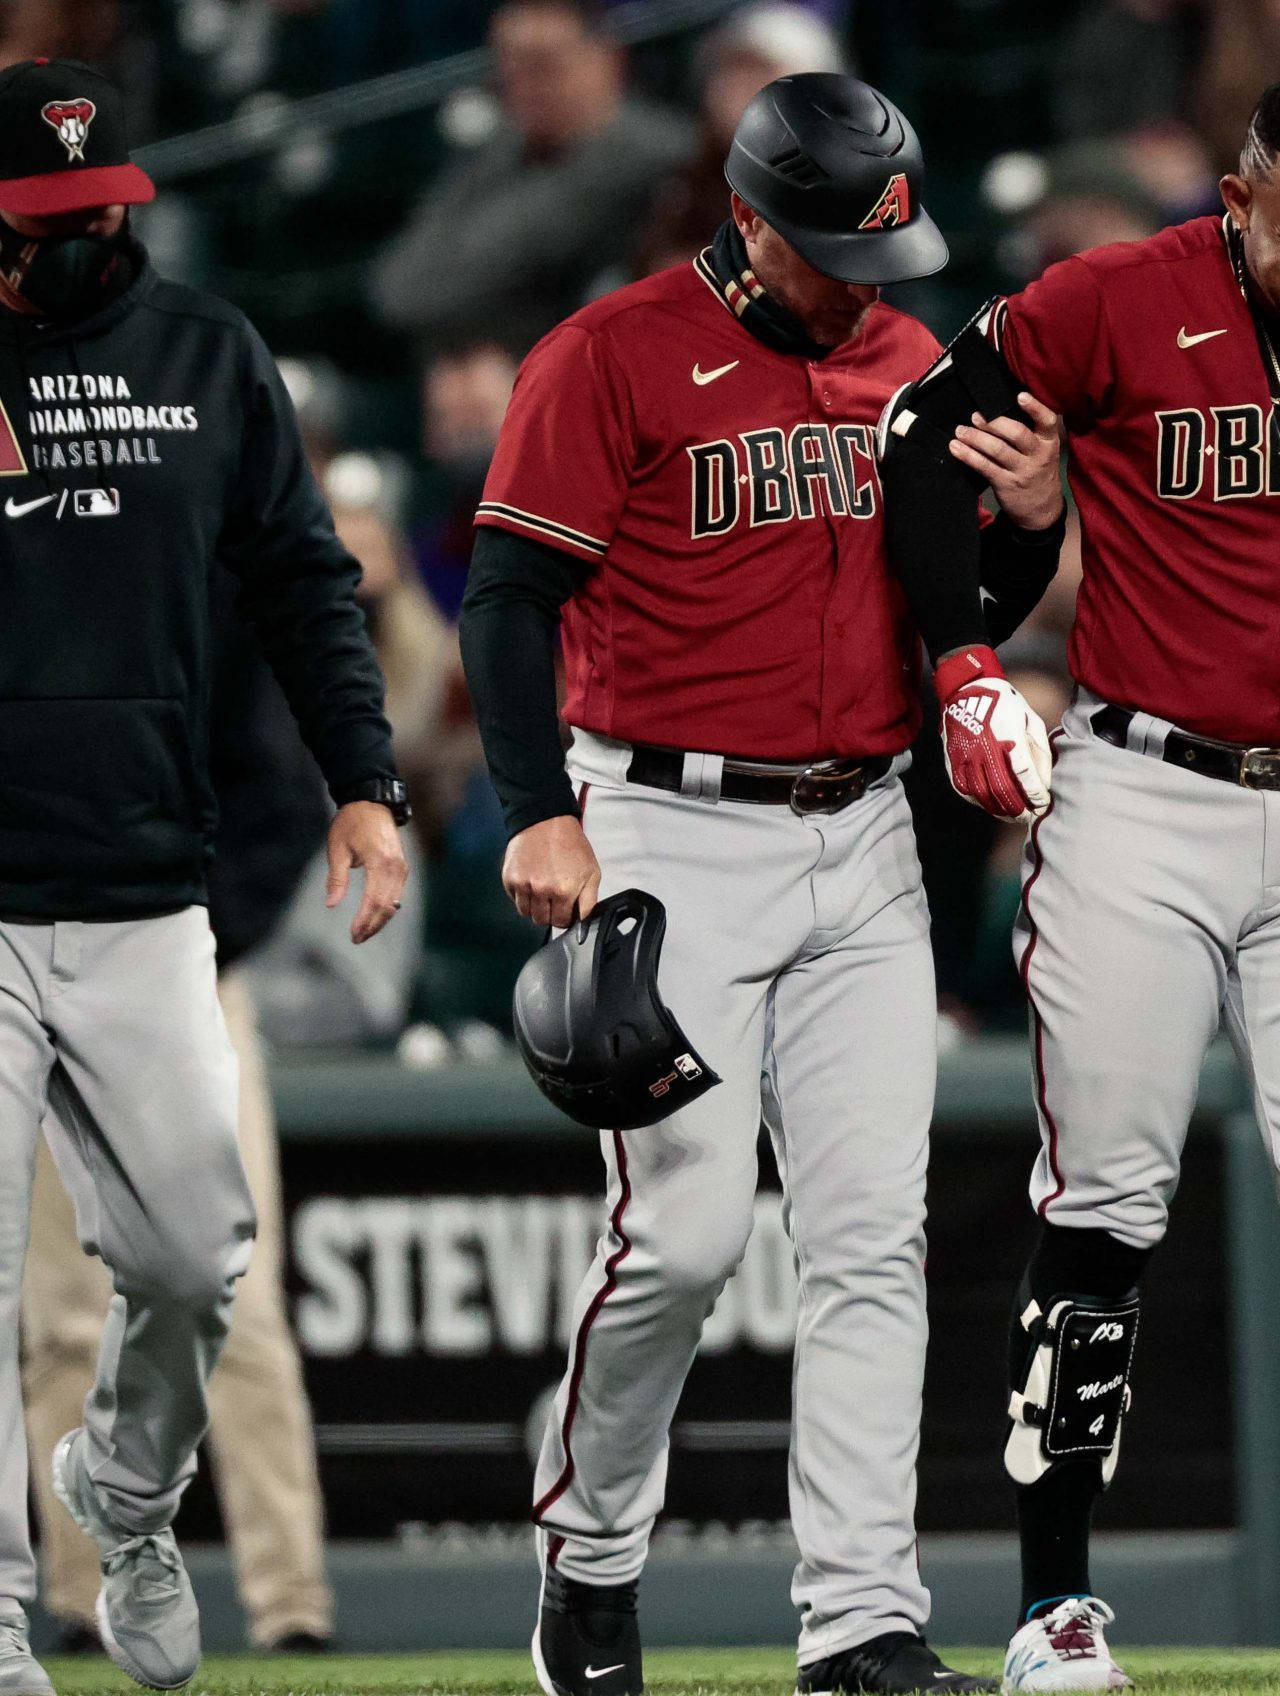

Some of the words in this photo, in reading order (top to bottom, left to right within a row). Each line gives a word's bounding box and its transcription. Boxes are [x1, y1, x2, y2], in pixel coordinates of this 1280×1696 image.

[948, 703, 985, 736] adidas
[1077, 1374, 1124, 1401] Marte
[1088, 1414, 1105, 1436] 4
